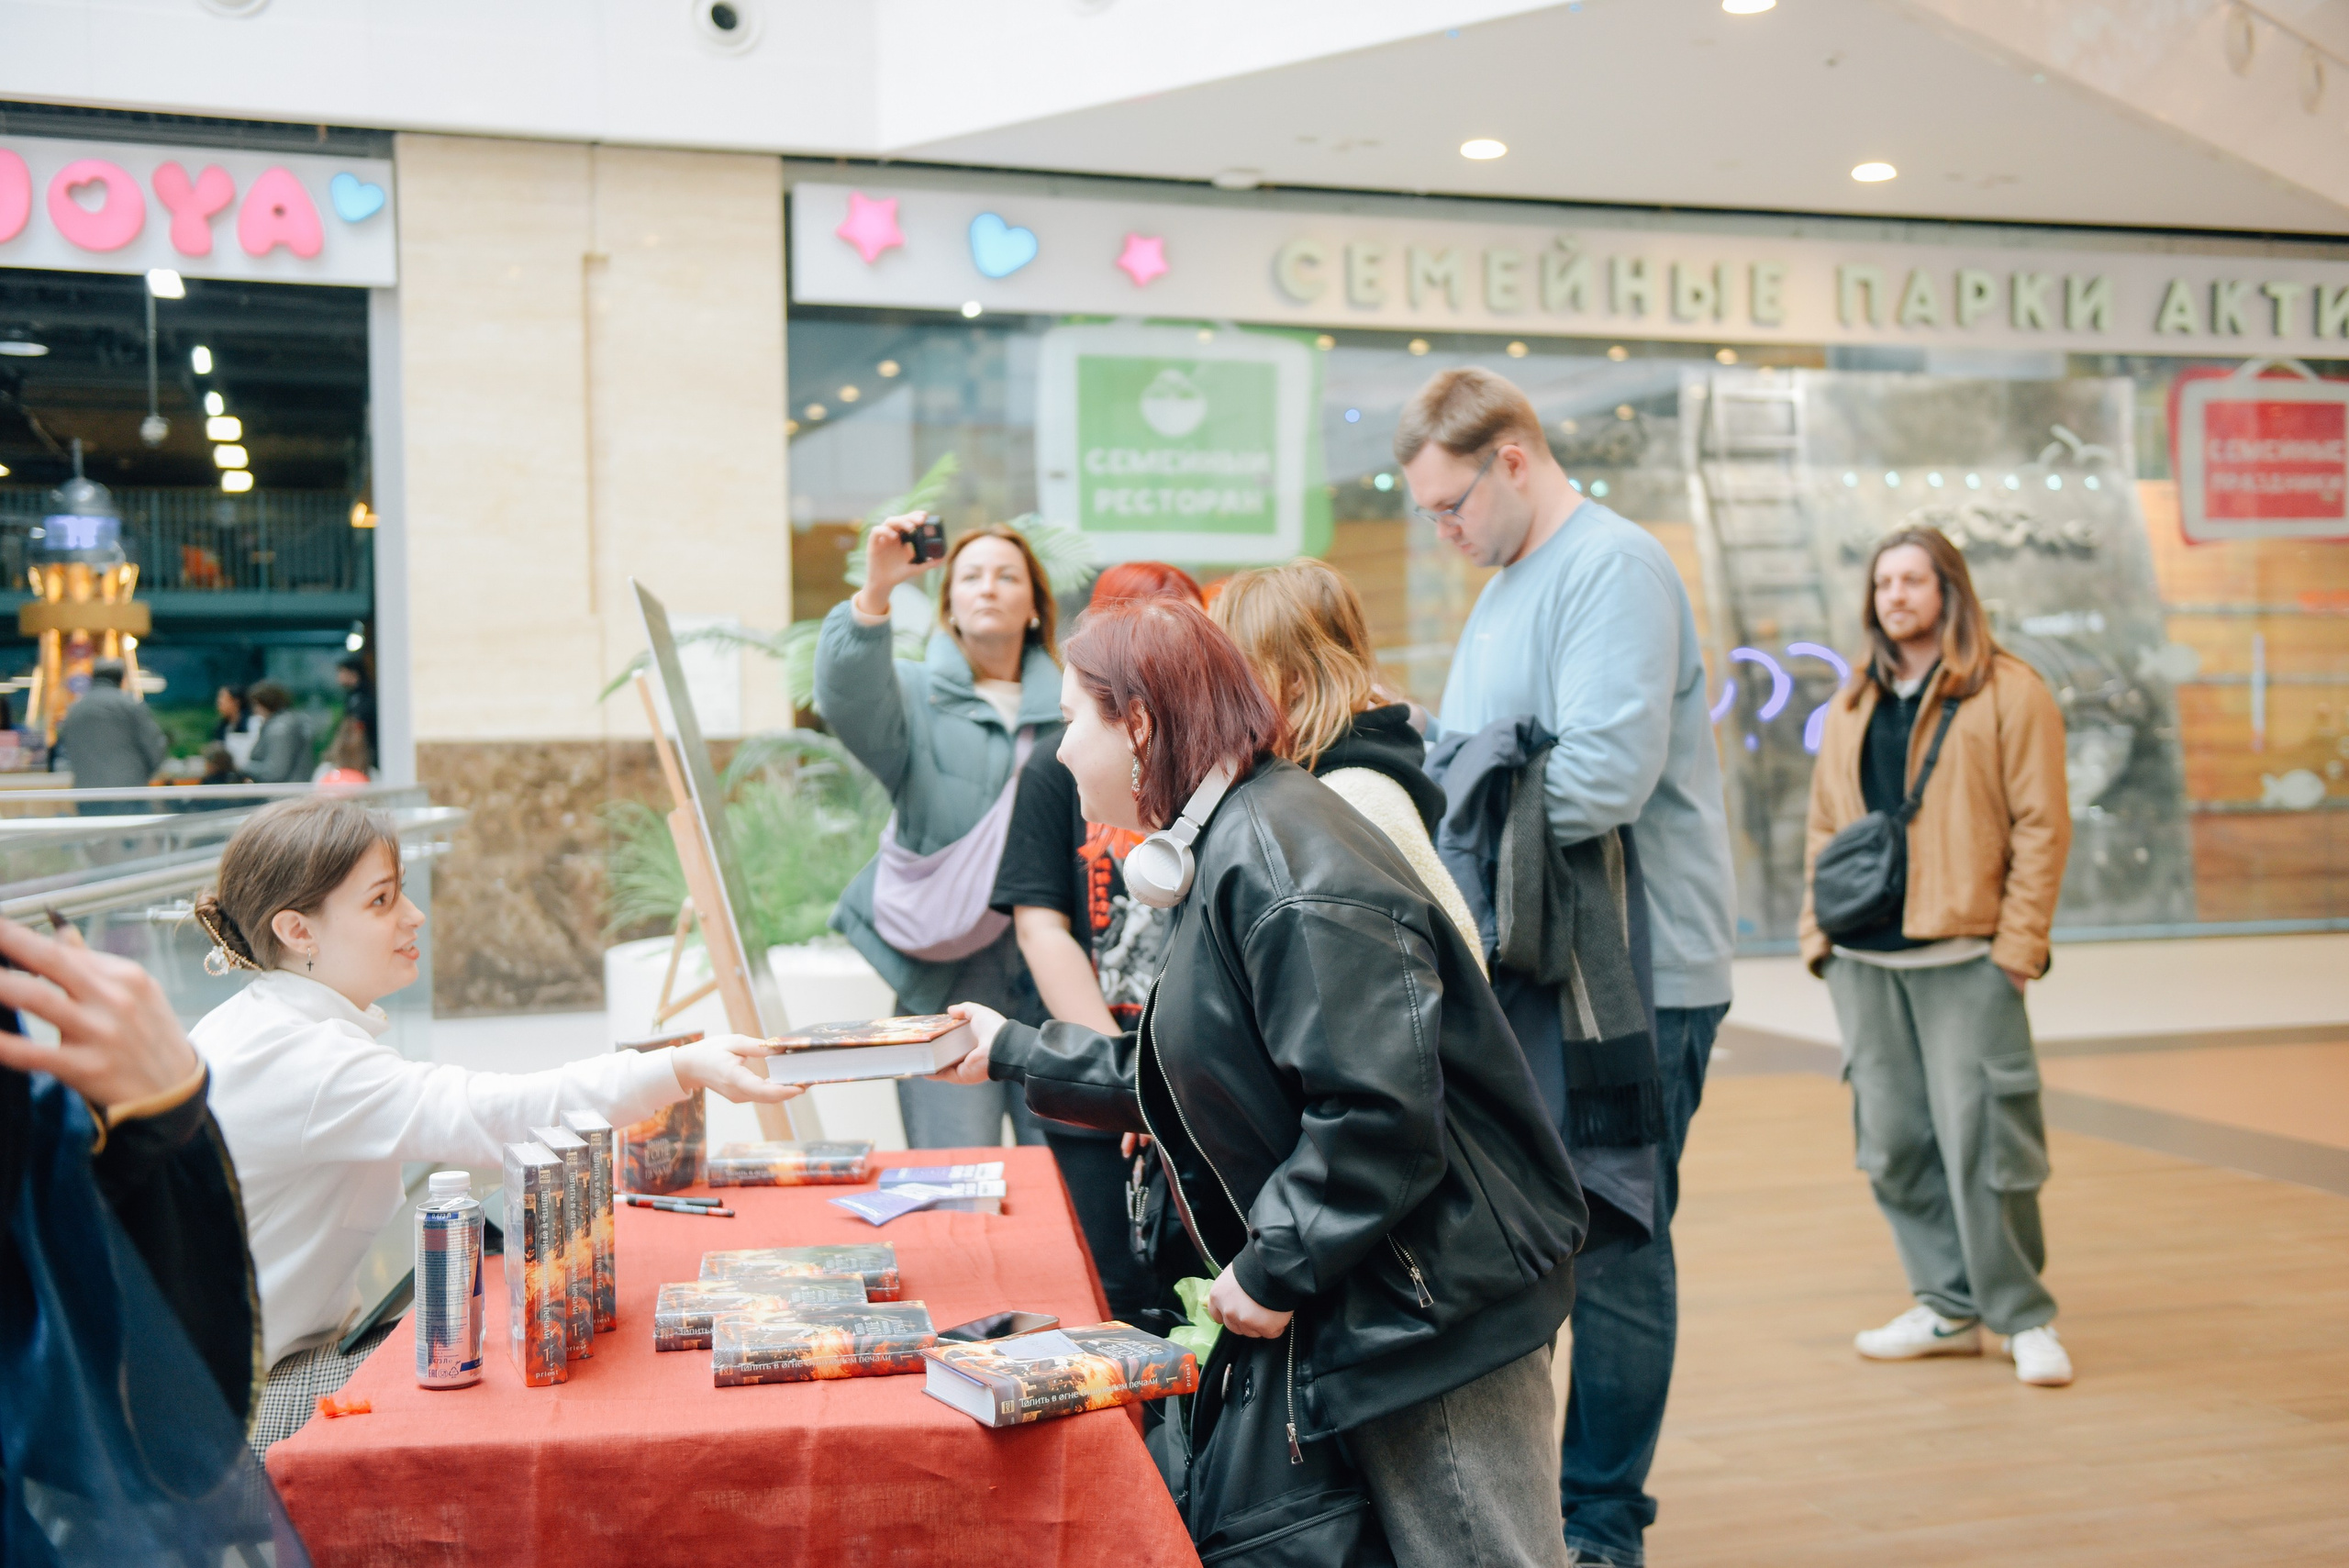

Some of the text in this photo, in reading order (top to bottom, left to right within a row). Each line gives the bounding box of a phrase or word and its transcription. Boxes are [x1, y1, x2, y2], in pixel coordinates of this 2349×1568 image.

[1274, 237, 2349, 339] СЕМЕЙНЫЕ ПАРКИ АКТИ
[1093, 487, 1265, 517] РЕСТОРАН
[858, 1353, 892, 1365] печали
[535, 1370, 560, 1379] priest
[1129, 1376, 1158, 1390] печали
